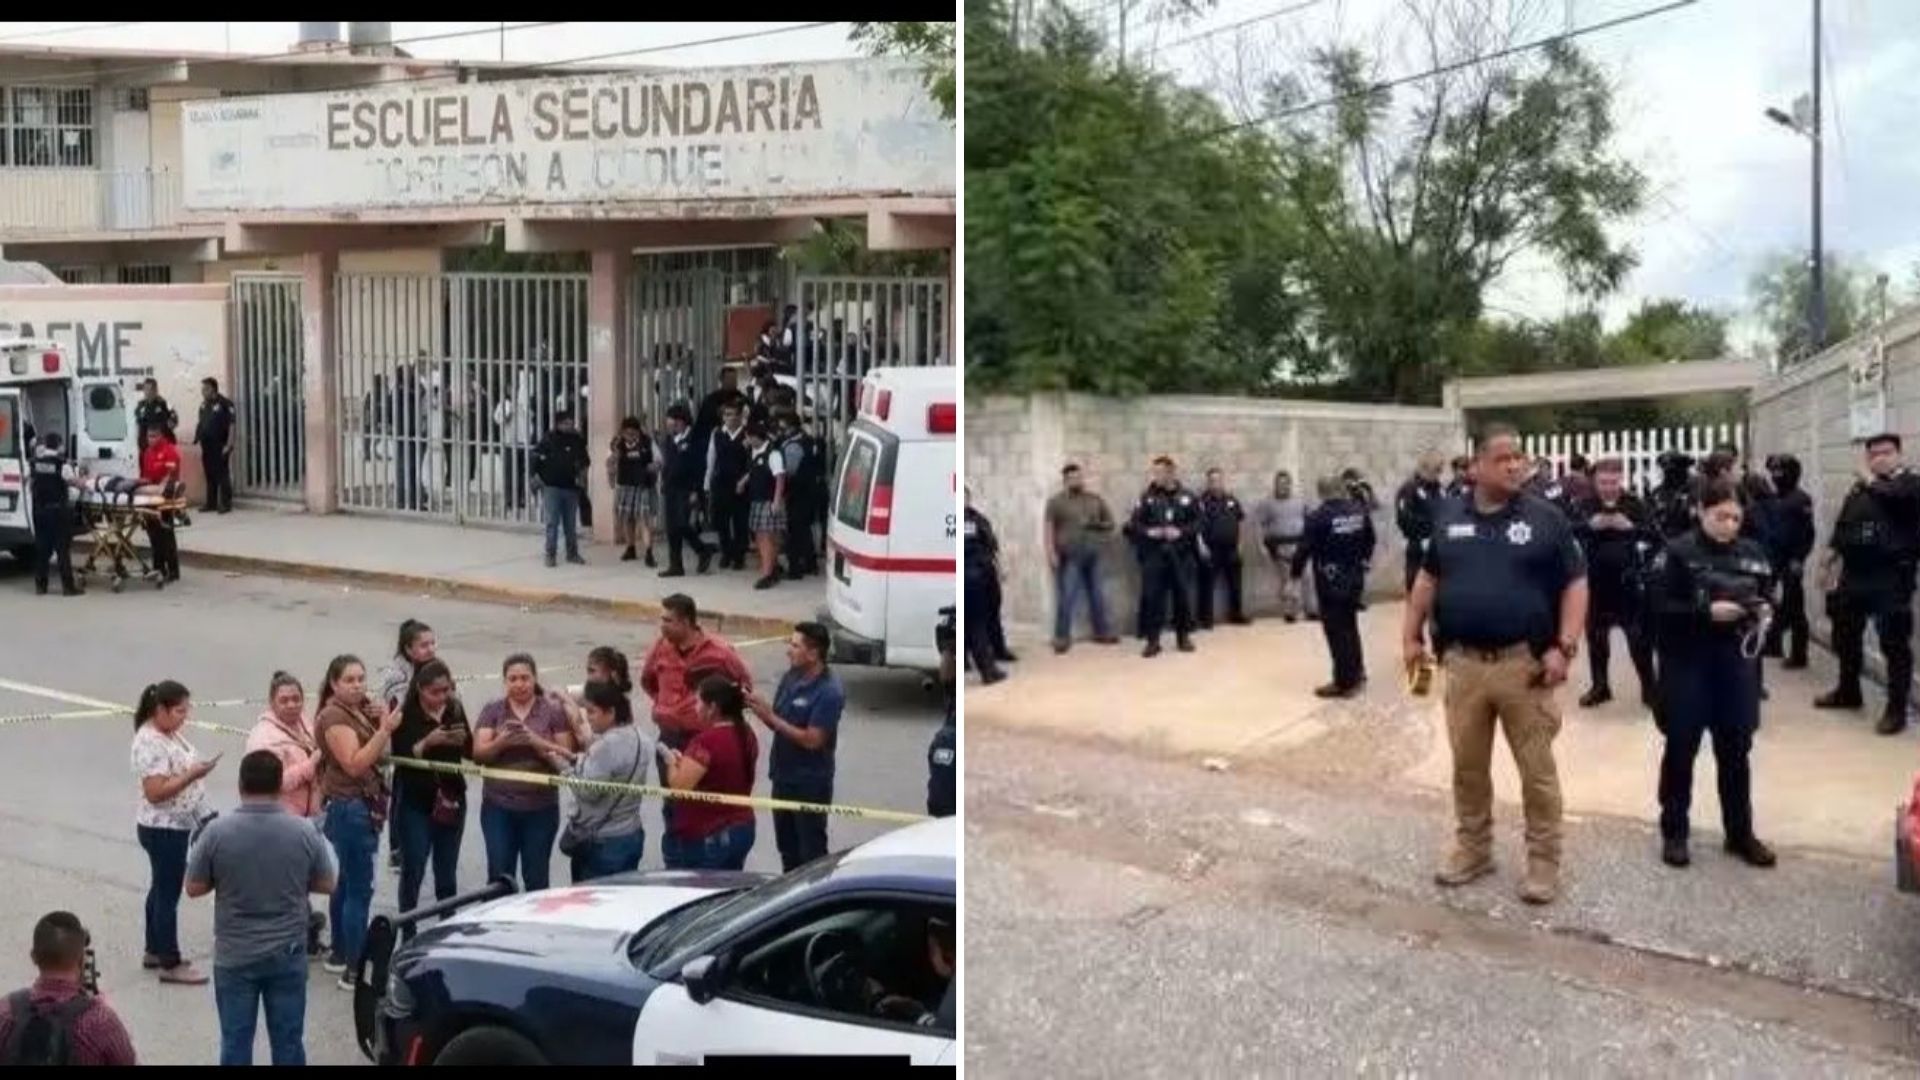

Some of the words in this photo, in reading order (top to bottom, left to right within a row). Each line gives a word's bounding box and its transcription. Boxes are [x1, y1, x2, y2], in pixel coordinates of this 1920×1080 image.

[327, 93, 514, 151] ESCUELA
[533, 74, 823, 142] SECUNDARIA
[546, 151, 567, 191] A
